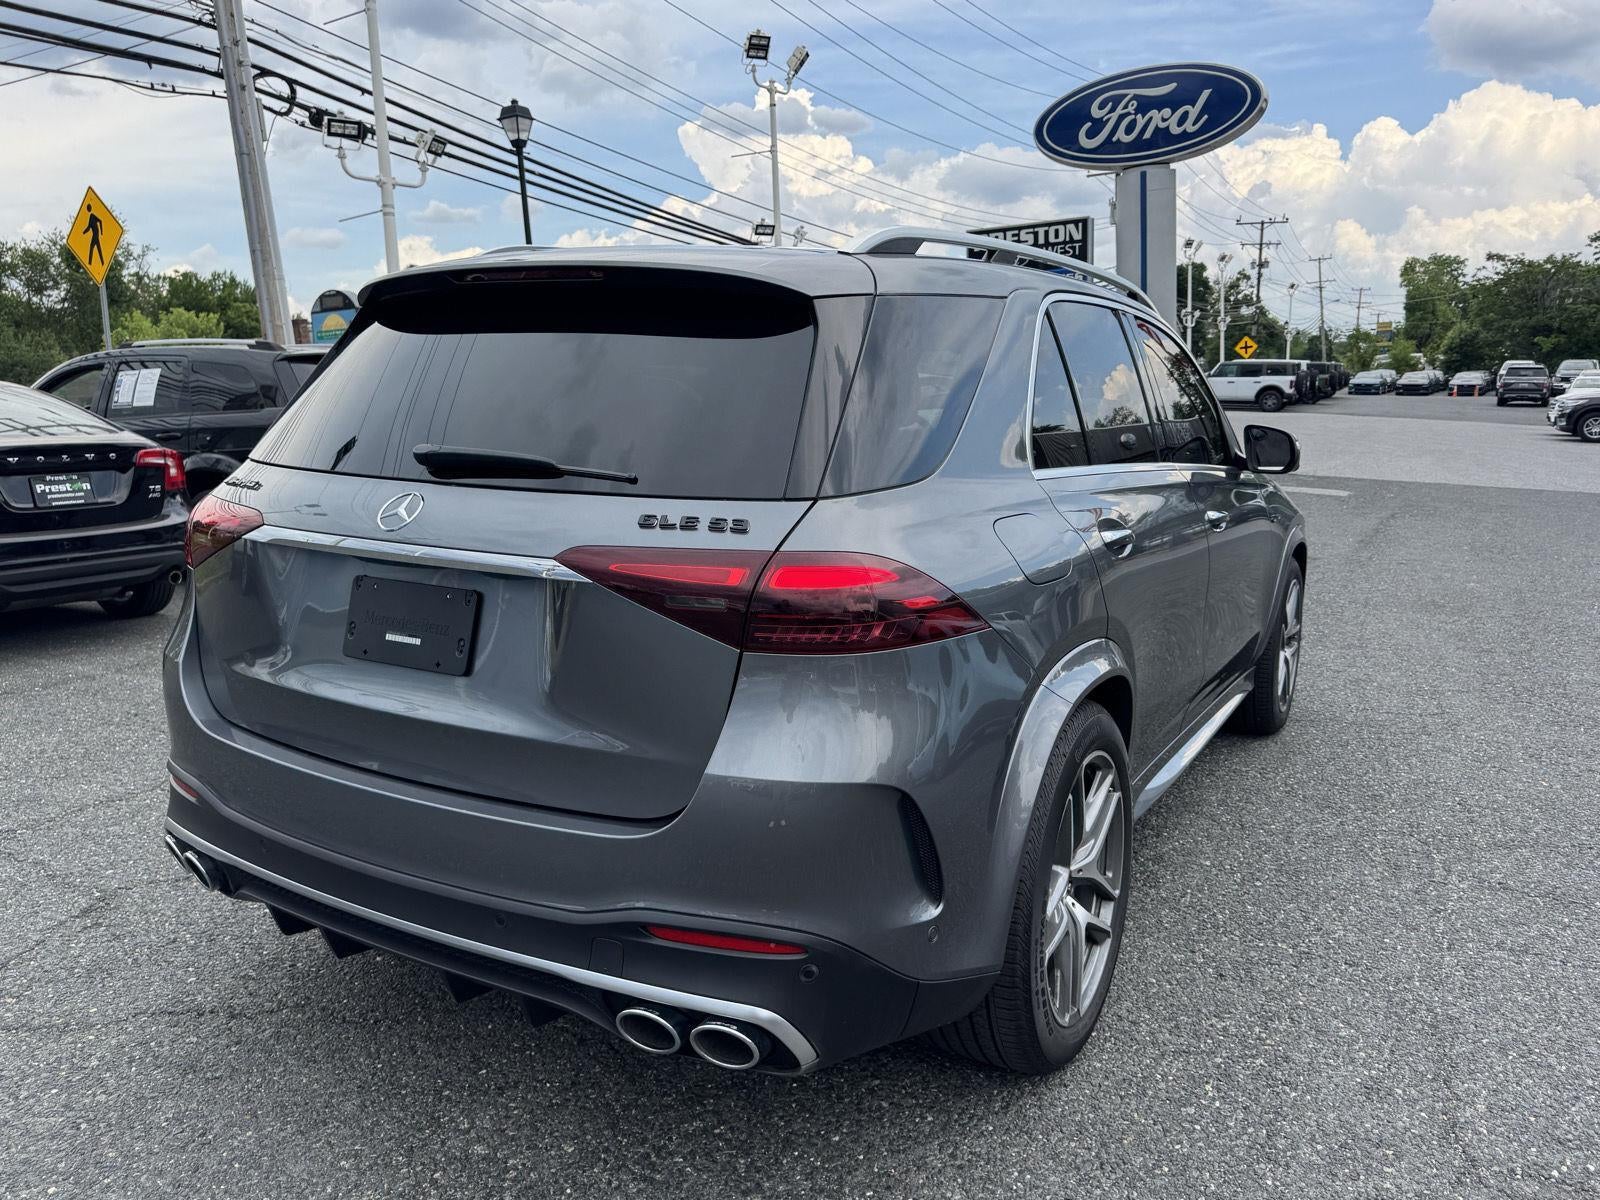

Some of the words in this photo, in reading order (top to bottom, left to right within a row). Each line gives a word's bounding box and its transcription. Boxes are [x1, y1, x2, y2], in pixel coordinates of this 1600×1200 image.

[1078, 82, 1212, 149] Ford
[980, 222, 1082, 246] ESTON
[7, 453, 117, 464] VOLVO
[638, 514, 700, 530] GLE
[707, 517, 750, 534] 53
